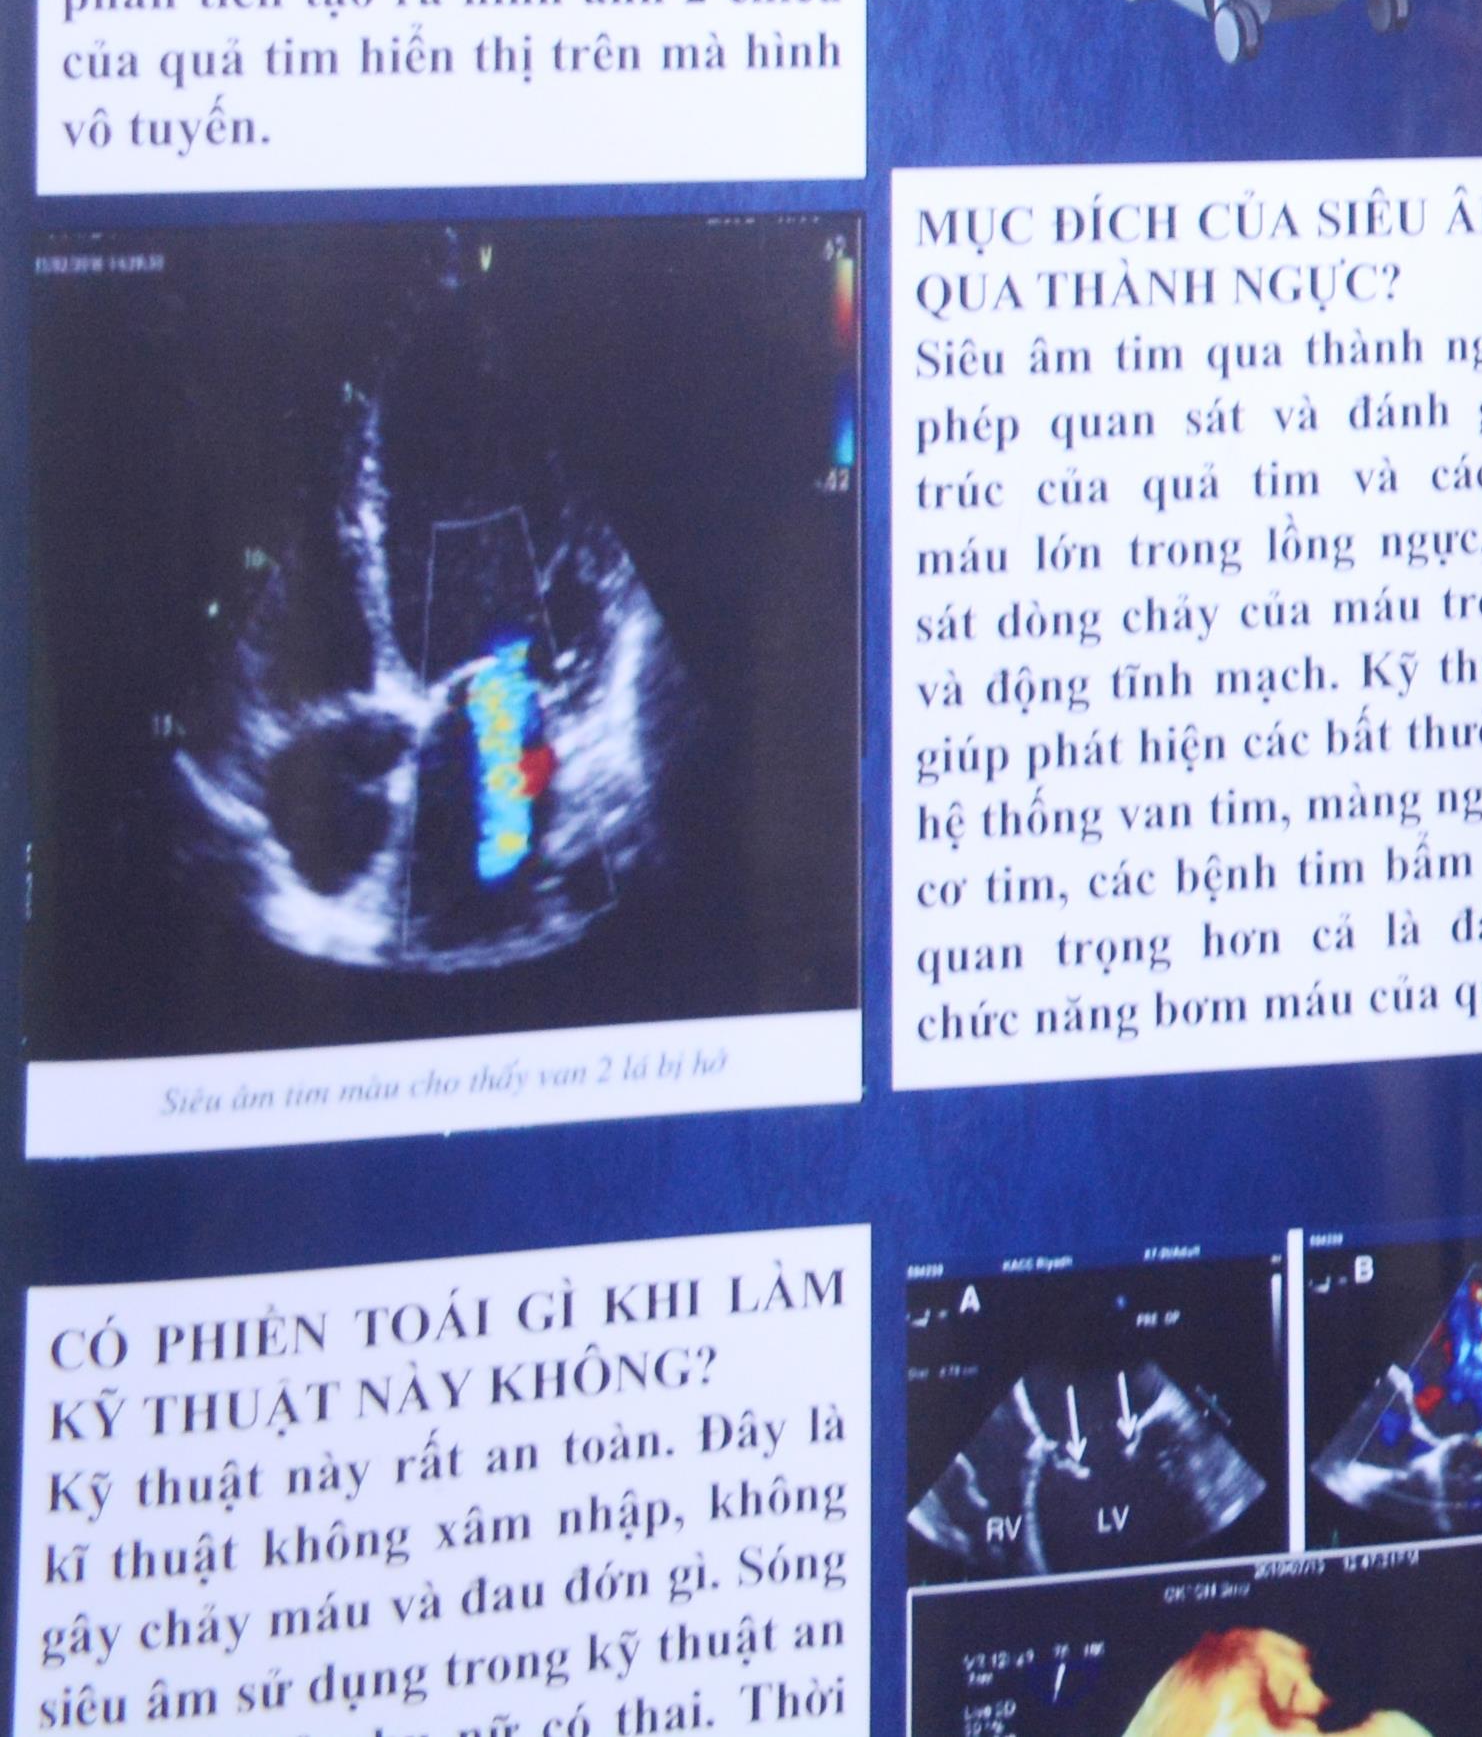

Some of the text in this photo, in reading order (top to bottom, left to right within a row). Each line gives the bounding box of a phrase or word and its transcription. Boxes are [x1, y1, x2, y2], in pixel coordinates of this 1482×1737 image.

[63, 94, 270, 157] vô tuyến.
[918, 207, 1033, 257] MỤC
[1053, 193, 1177, 242] ĐÍCH
[1198, 190, 1300, 240] CỦA
[1317, 186, 1425, 237] SIÊU
[917, 1000, 1018, 1042] chức
[1036, 997, 1139, 1040] năng
[1155, 990, 1247, 1027] bơm
[1265, 980, 1352, 1021] máu
[1369, 976, 1438, 1014] của
[597, 1056, 612, 1083] 2
[1355, 1255, 1374, 1283] B
[50, 1259, 844, 1371] CÓ PHIỀN TOÁI GÌ KHI LÀM
[959, 1284, 980, 1313] A
[45, 1475, 847, 1586] kĩ thuật không xâm nhập, không
[986, 1516, 1021, 1542] RV
[1098, 1505, 1129, 1533] LV
